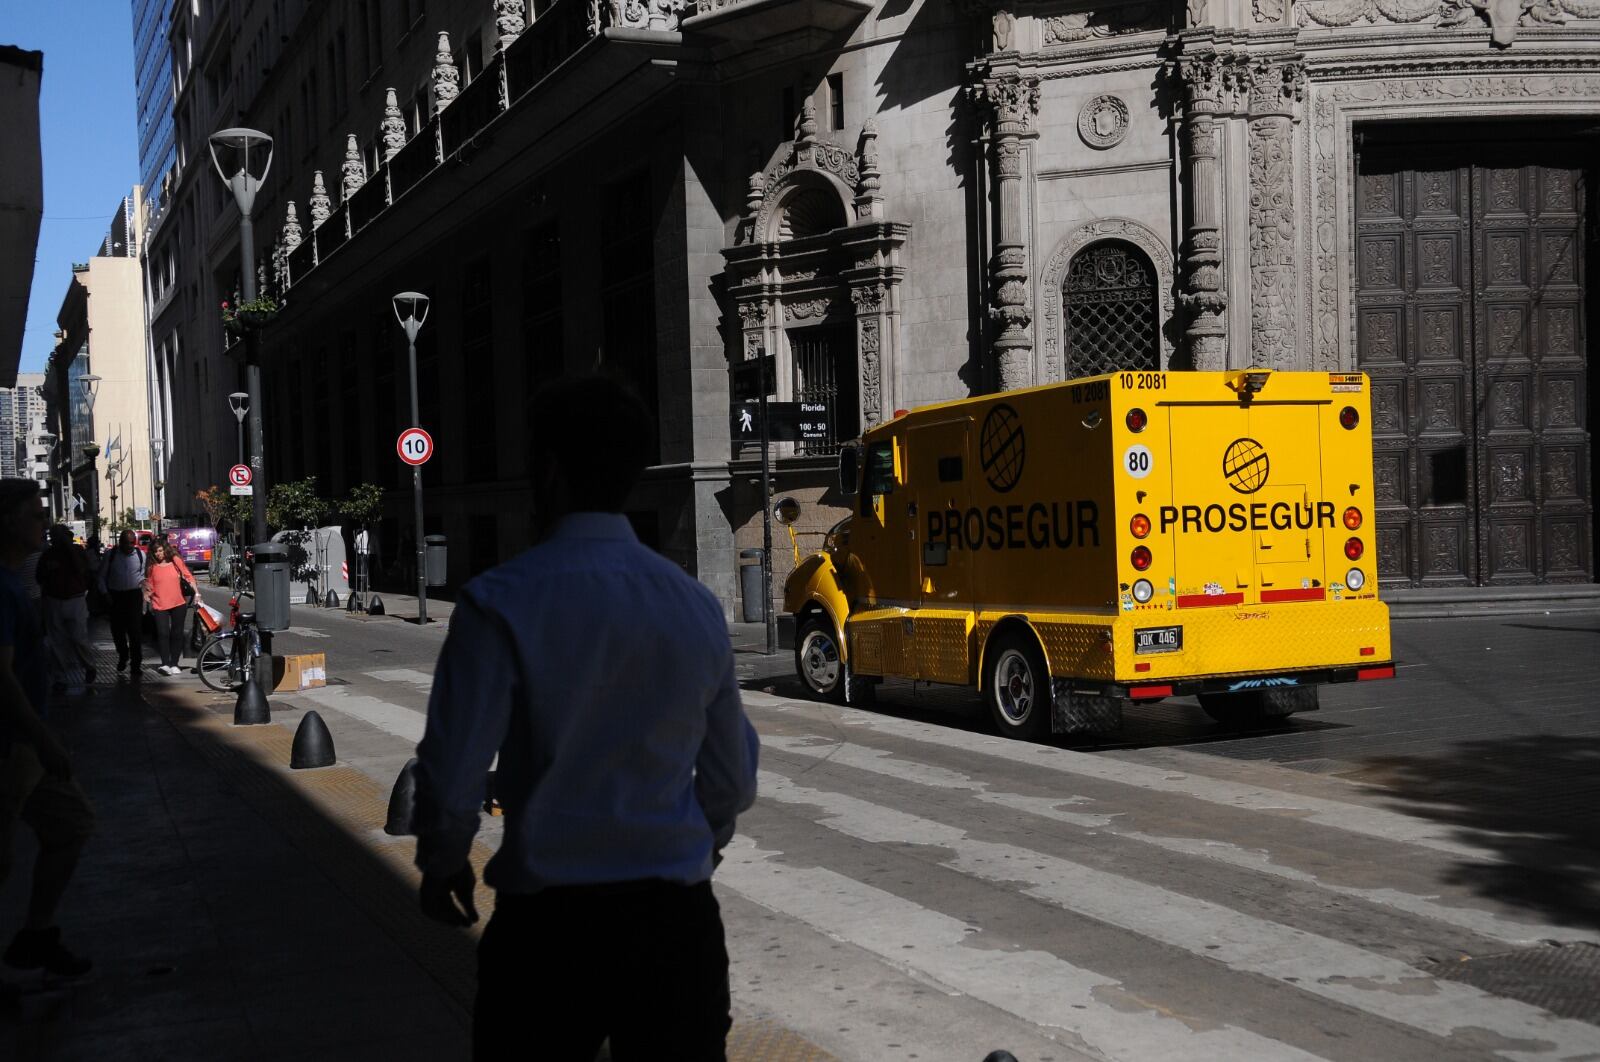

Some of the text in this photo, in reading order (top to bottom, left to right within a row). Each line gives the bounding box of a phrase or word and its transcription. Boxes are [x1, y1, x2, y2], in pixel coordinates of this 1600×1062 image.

[1120, 373, 1167, 389] 10 2081
[1071, 382, 1109, 403] 10 2081
[801, 404, 826, 412] Florida
[799, 423, 812, 431] 100
[817, 423, 826, 431] 50
[404, 438, 425, 454] 10
[1128, 451, 1149, 471] 80
[928, 500, 1100, 551] PROSEGUR
[1159, 501, 1336, 534] PROSEGUR
[1158, 631, 1176, 645] 446
